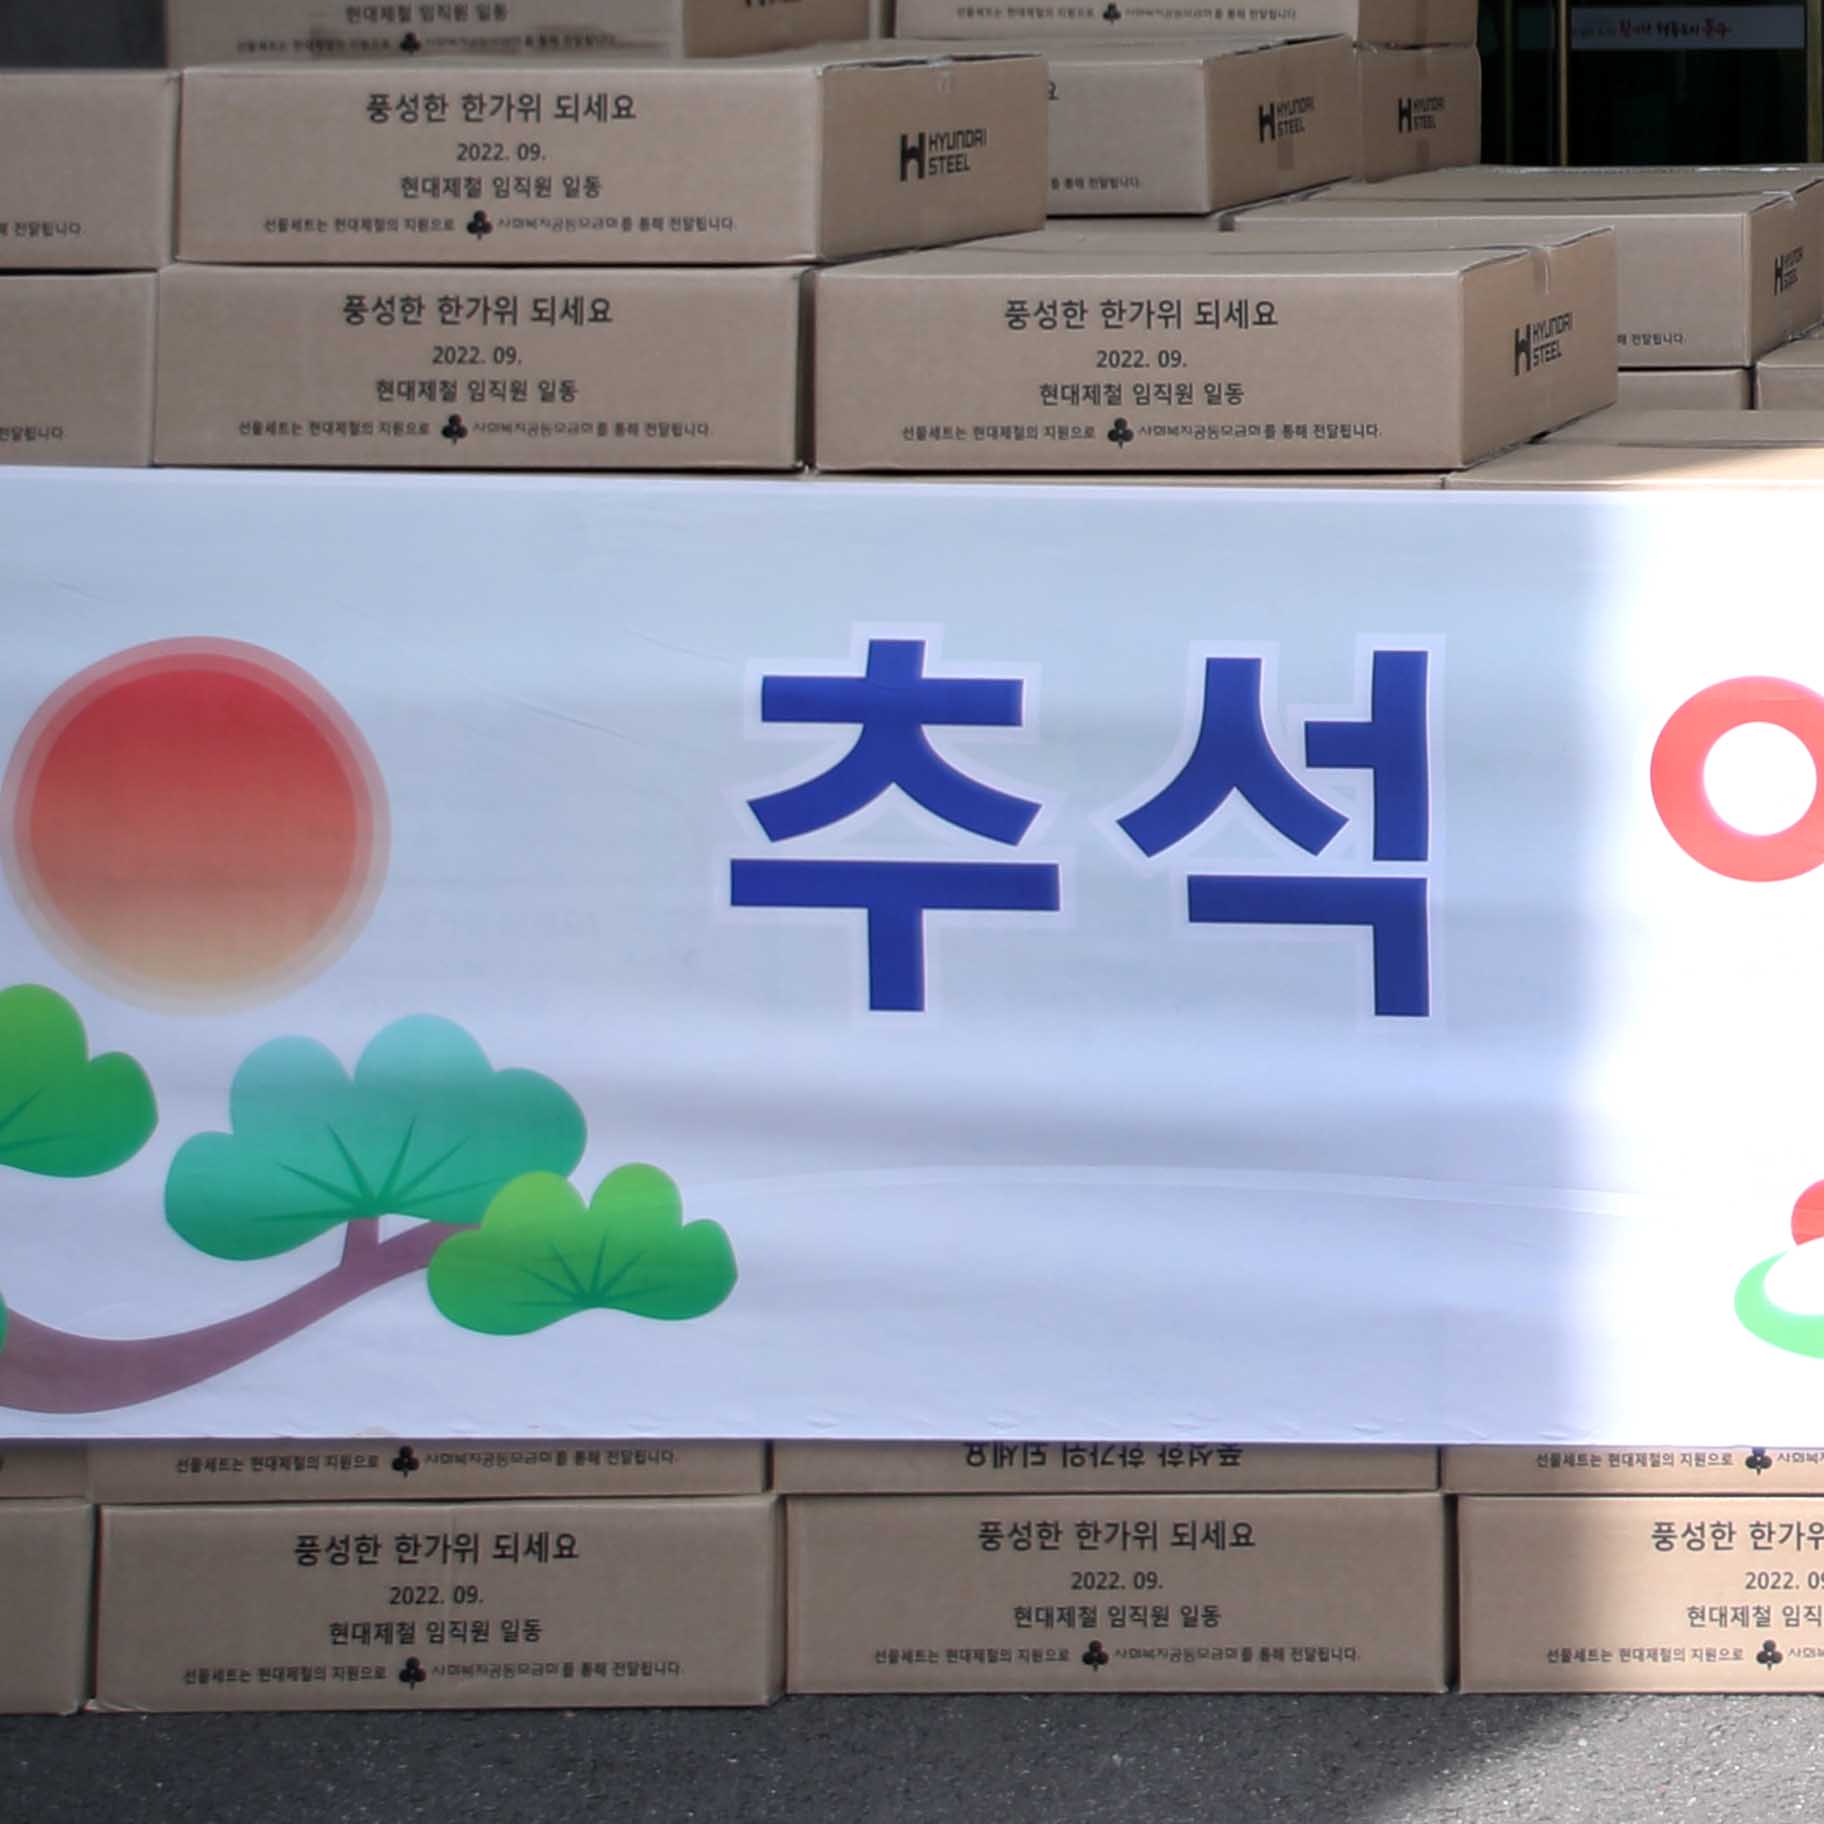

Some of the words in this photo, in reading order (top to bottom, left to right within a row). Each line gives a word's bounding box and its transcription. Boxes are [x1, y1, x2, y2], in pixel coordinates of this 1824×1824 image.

[366, 93, 449, 124] 풍성한
[461, 92, 541, 123] 한가위
[553, 92, 636, 123] 되세요
[928, 127, 988, 152] HYUNDAI
[456, 142, 509, 162] 2022.
[515, 142, 546, 162] 09.
[928, 153, 971, 176] STEEL
[400, 176, 486, 199] 현대제철
[491, 176, 552, 199] 임직원
[562, 176, 602, 199] 일동
[729, 638, 1431, 1016] 추석
[978, 1520, 1063, 1552] 풍성한
[1074, 1520, 1157, 1552] 한가위
[1170, 1520, 1256, 1551] 되세요
[1070, 1571, 1126, 1591] 2022.
[1130, 1571, 1163, 1590] 09.
[1013, 1605, 1097, 1629] 현대제철
[1107, 1605, 1169, 1629] 임직원
[1178, 1605, 1222, 1628] 일동
